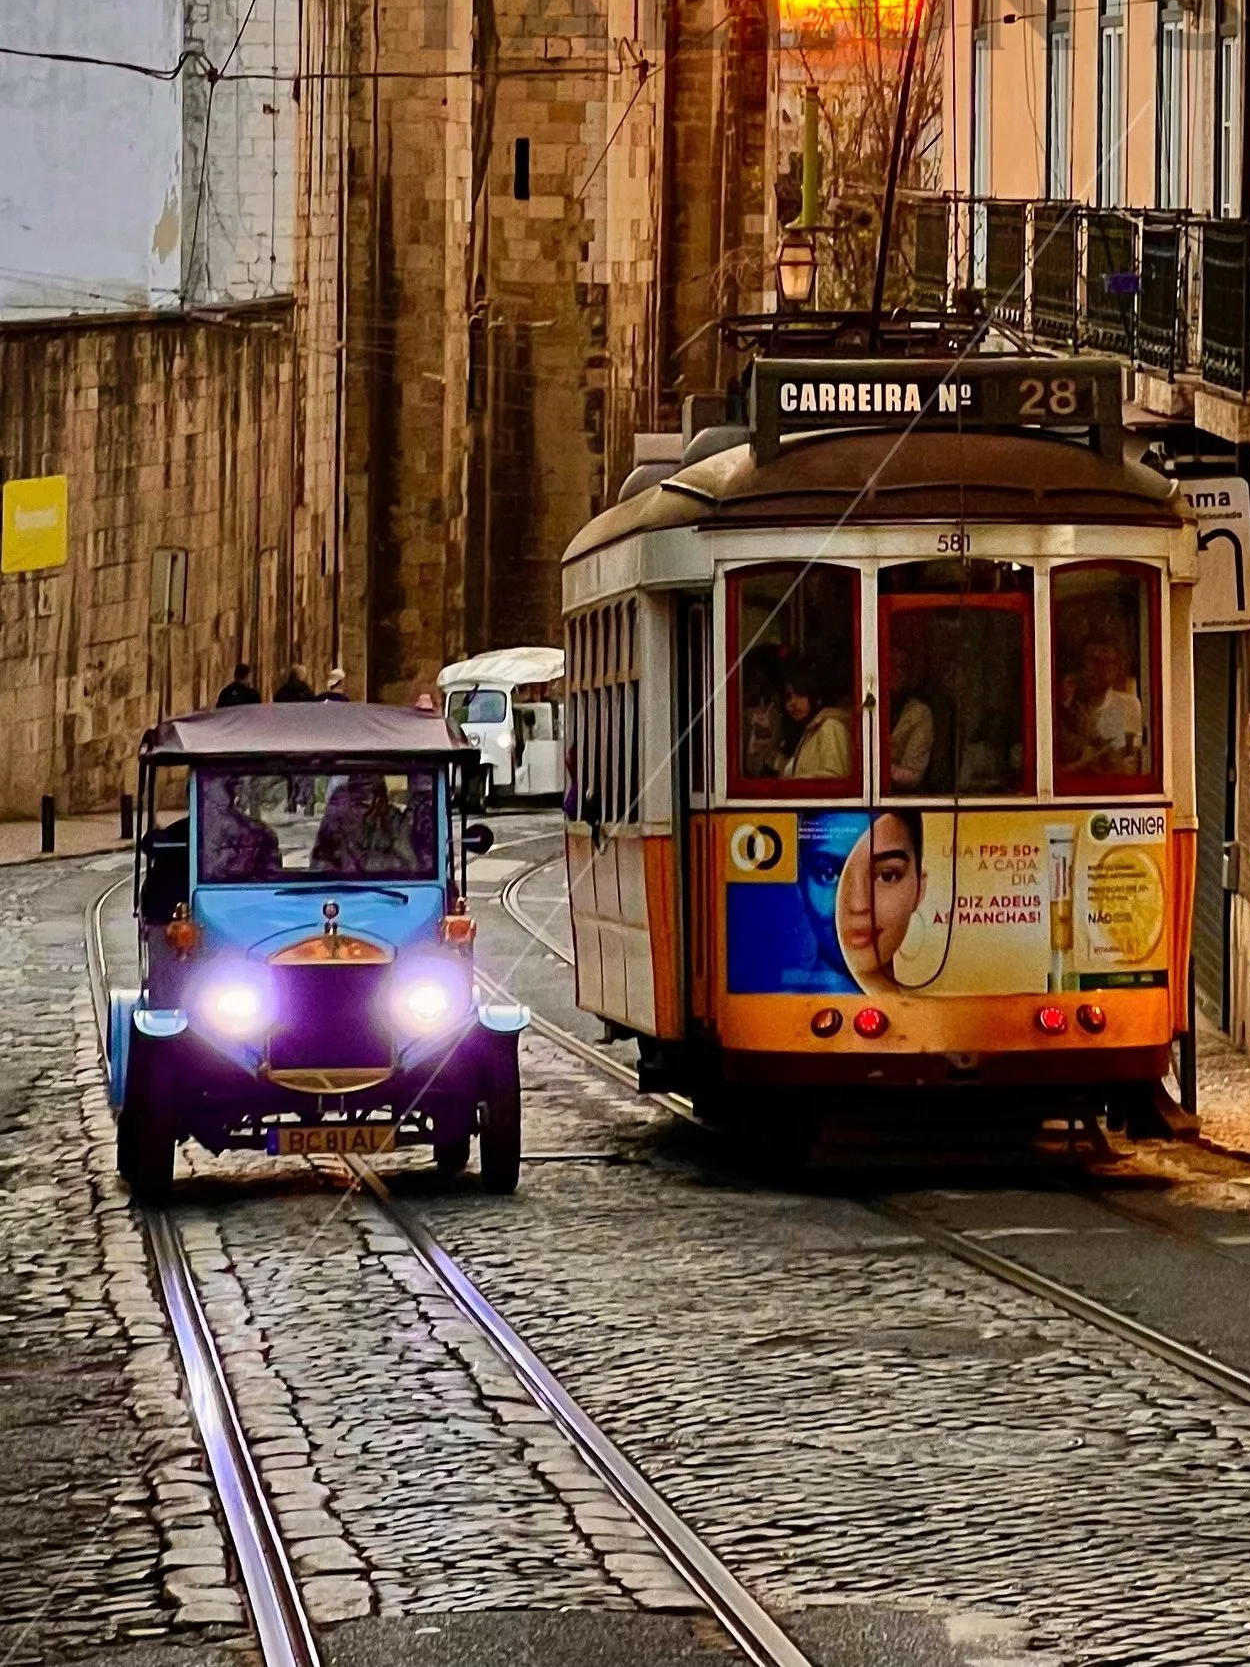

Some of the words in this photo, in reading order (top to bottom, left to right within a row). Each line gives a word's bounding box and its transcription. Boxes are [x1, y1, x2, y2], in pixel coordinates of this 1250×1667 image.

[780, 382, 921, 412] CARREIRA
[938, 383, 971, 412] Nº
[1018, 379, 1077, 415] 28
[936, 533, 971, 553] 581
[979, 844, 1008, 857] FPS
[1013, 844, 1040, 857] 50+
[977, 859, 989, 870] A
[993, 858, 1037, 871] CADA
[1011, 872, 1038, 886] DIA
[956, 895, 984, 908] DIZ
[988, 894, 1042, 908] ADEUS
